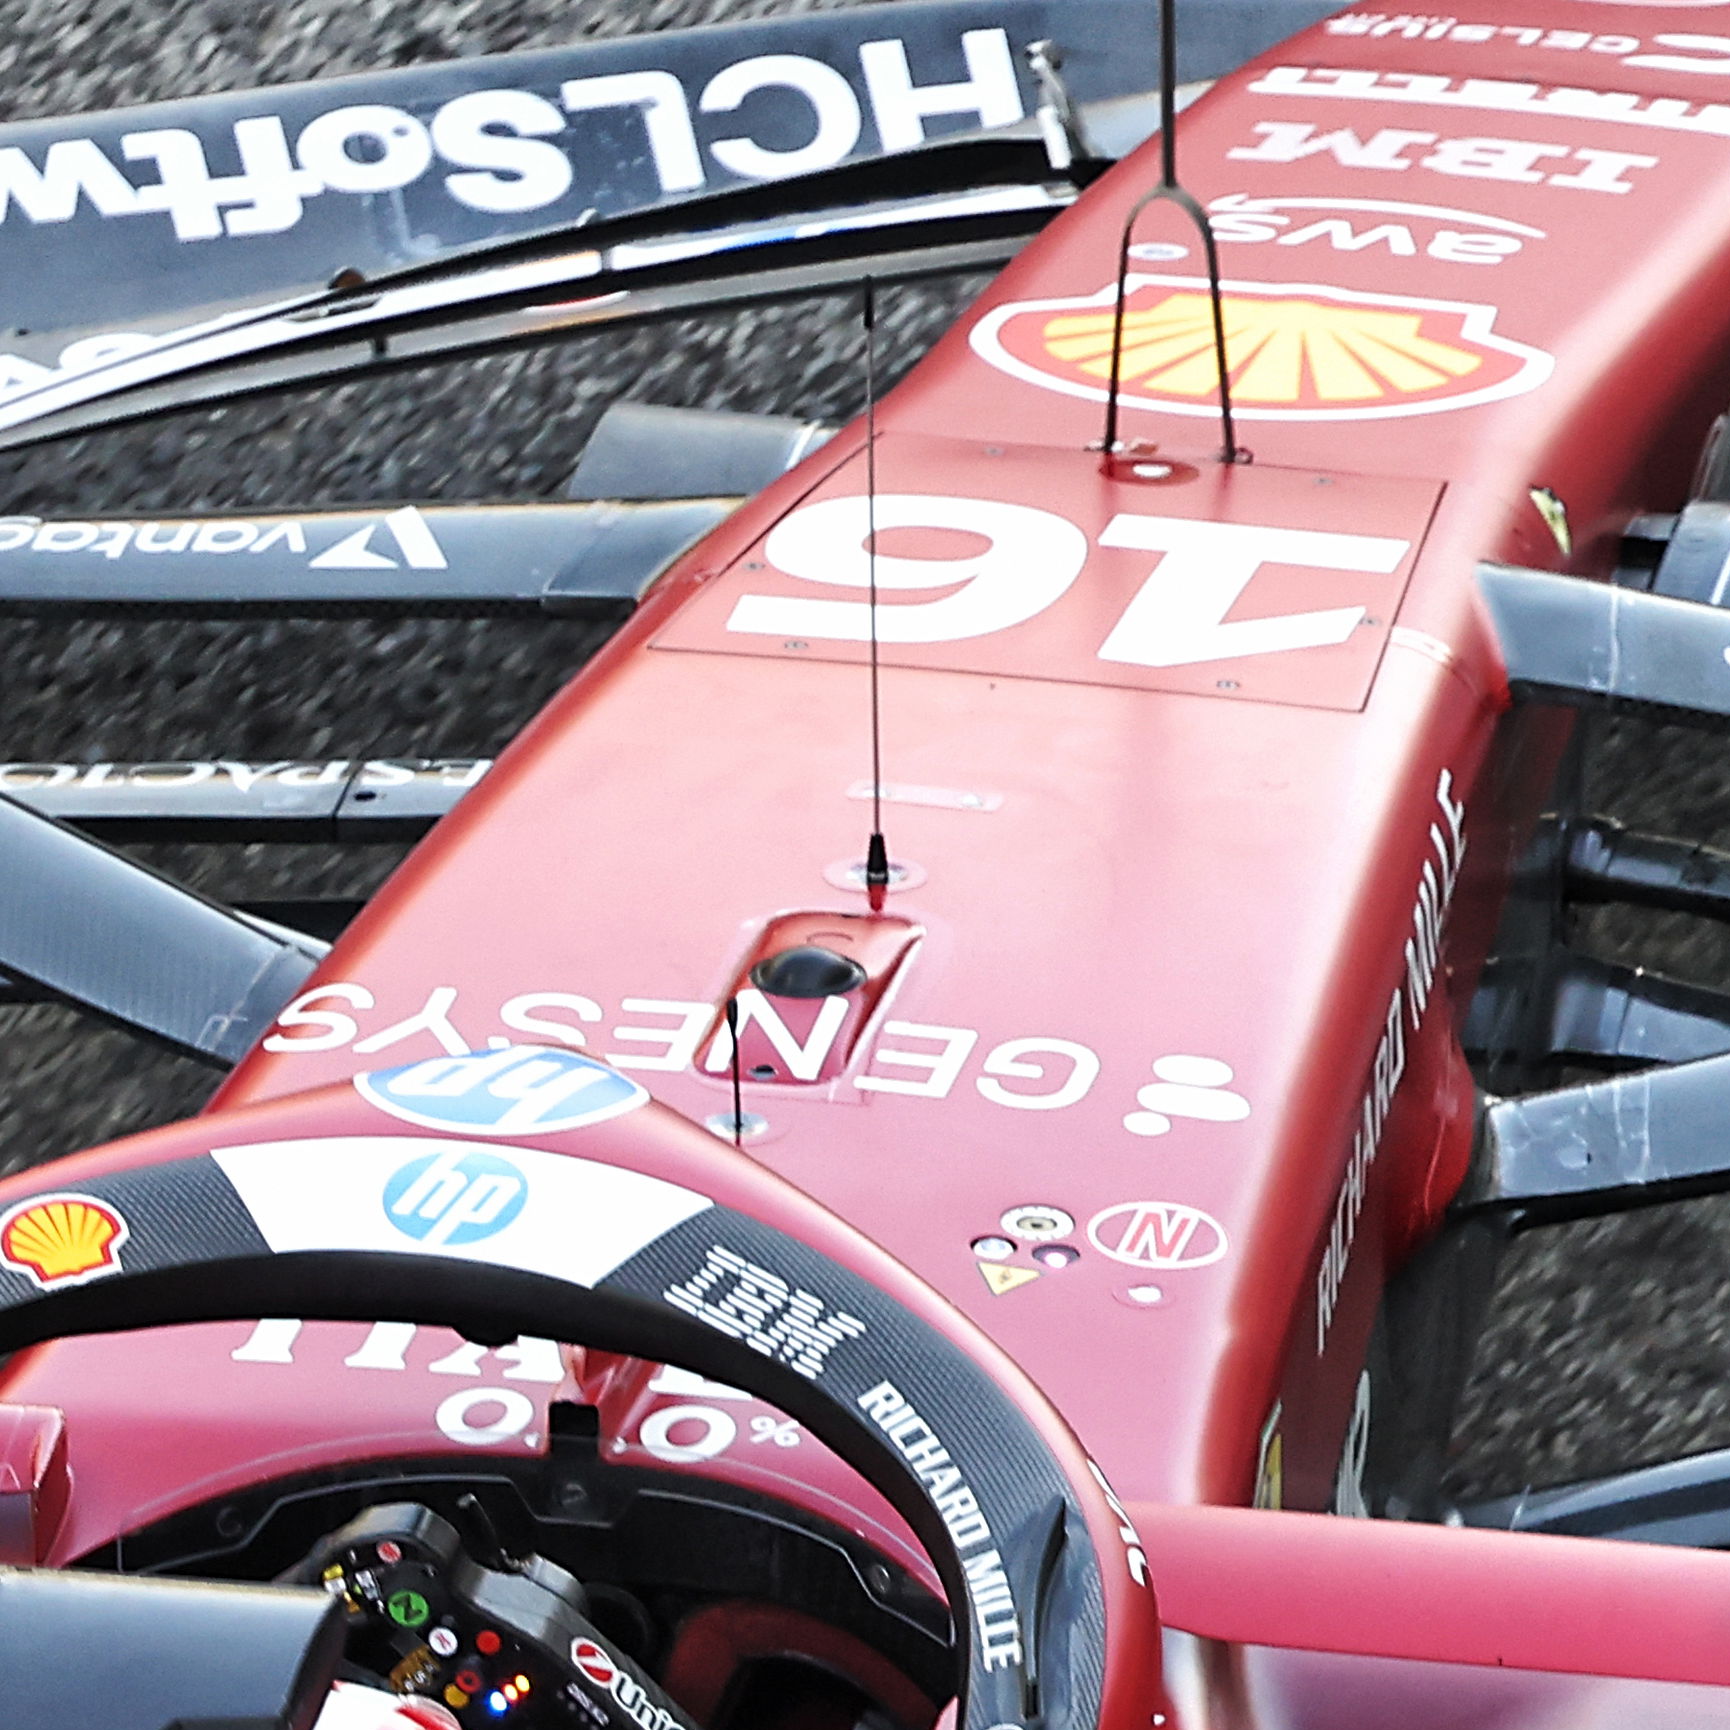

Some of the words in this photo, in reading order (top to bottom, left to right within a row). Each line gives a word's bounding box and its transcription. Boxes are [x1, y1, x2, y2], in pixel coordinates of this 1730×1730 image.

[1228, 122, 1657, 193] IBM
[1209, 193, 1545, 264] aws
[726, 495, 1410, 666] 16
[264, 982, 1100, 1111] GENESYS
[391, 1152, 521, 1244] hp
[662, 1245, 865, 1380] IBM
[856, 1380, 991, 1559] RICHARD
[961, 1548, 1022, 1673] MILLE
